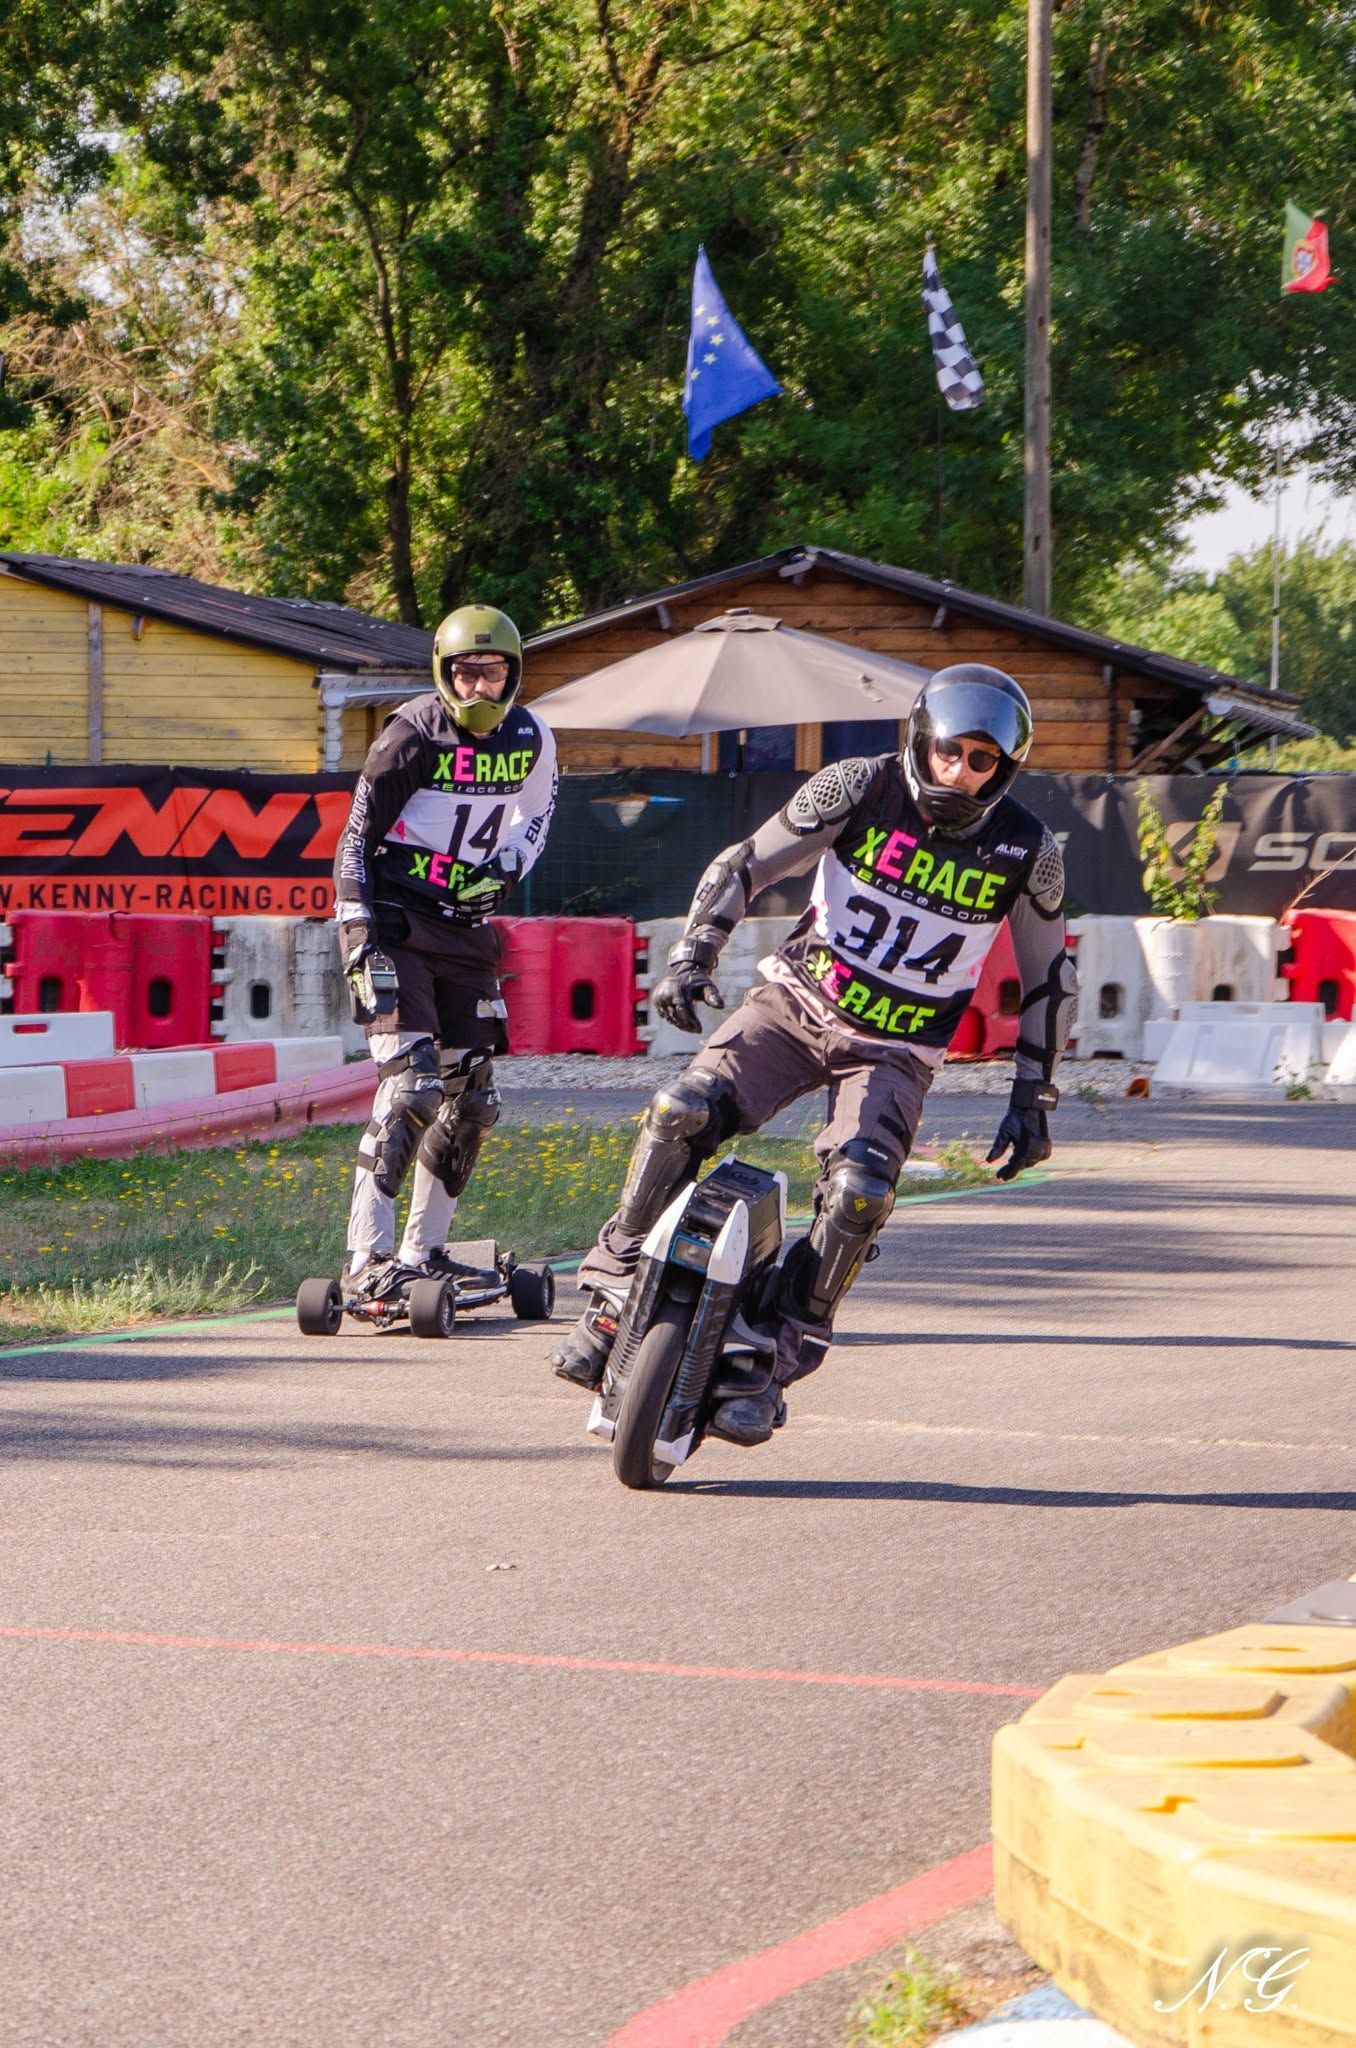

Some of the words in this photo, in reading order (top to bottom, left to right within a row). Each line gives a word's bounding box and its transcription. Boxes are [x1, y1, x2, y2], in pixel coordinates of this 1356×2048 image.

[432, 747, 534, 782] XERACE
[0, 788, 353, 859] ENNY
[447, 803, 506, 862] 14
[853, 826, 1007, 911] XERACE
[833, 895, 967, 985] 314
